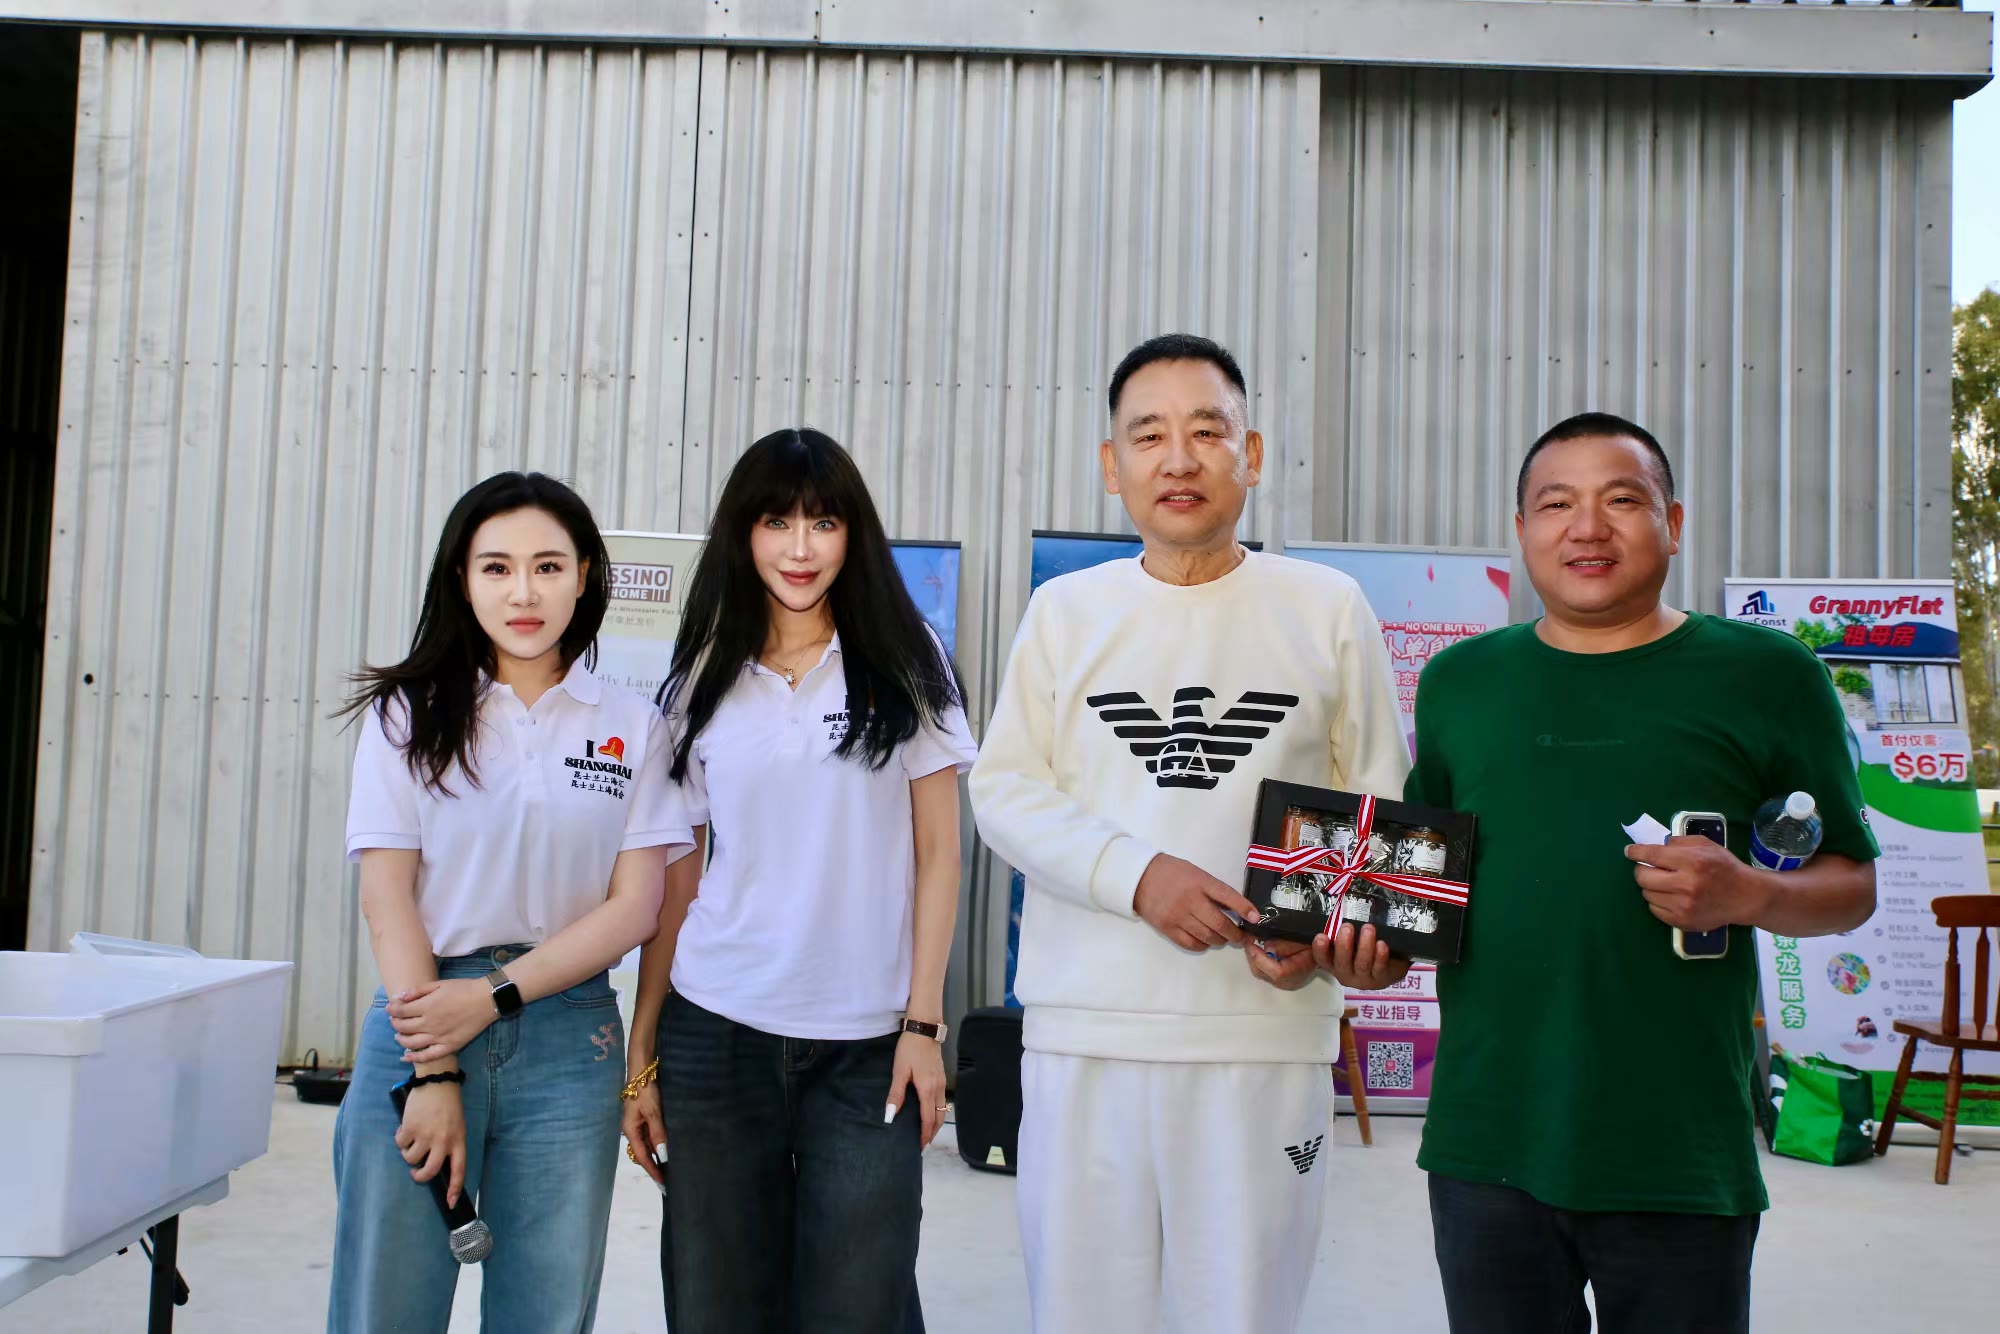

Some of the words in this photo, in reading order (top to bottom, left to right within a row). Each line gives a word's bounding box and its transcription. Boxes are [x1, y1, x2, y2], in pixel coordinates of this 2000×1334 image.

[1809, 595, 1944, 619] GrannyFlat
[1405, 622, 1420, 632] NO
[1422, 623, 1442, 633] ONE
[1444, 624, 1462, 633] BUT
[1464, 625, 1485, 634] YOU
[1843, 624, 1917, 648] 祖母房
[586, 739, 595, 758] I
[564, 757, 633, 780] SHANGHAI
[1894, 751, 1965, 779] $6万
[1390, 975, 1421, 990] 配对
[1360, 1004, 1421, 1021] 专业指导
